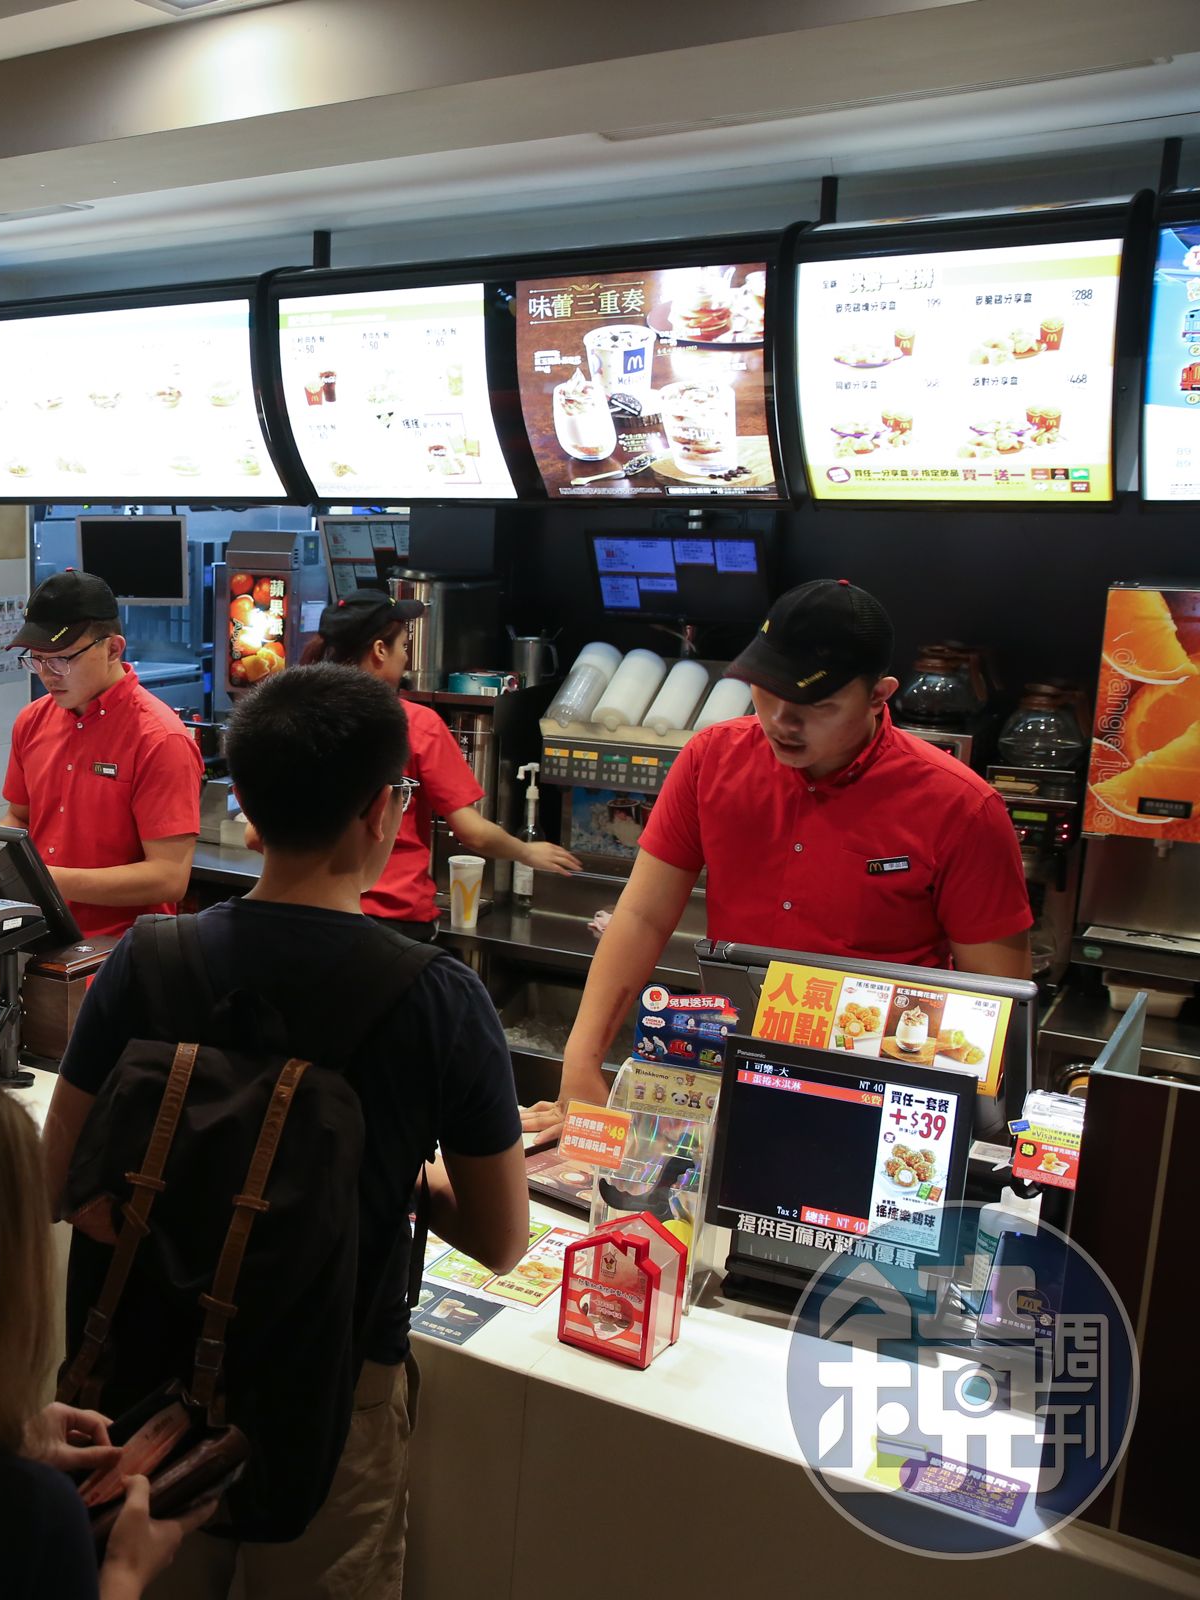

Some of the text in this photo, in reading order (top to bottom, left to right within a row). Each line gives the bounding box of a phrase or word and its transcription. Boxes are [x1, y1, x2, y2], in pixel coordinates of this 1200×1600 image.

[528, 288, 644, 319] 味蕾三重奏
[768, 973, 838, 1012] 人氣
[759, 1007, 829, 1049] 加點
[736, 1049, 767, 1059] Panasonic
[859, 1080, 871, 1090] NT
[873, 1083, 884, 1093] 40
[890, 1090, 950, 1114] 買任一套餐
[836, 1217, 850, 1228] NT
[853, 1221, 866, 1232] 40
[737, 1213, 917, 1270] 提供自備飲料杯優惠
